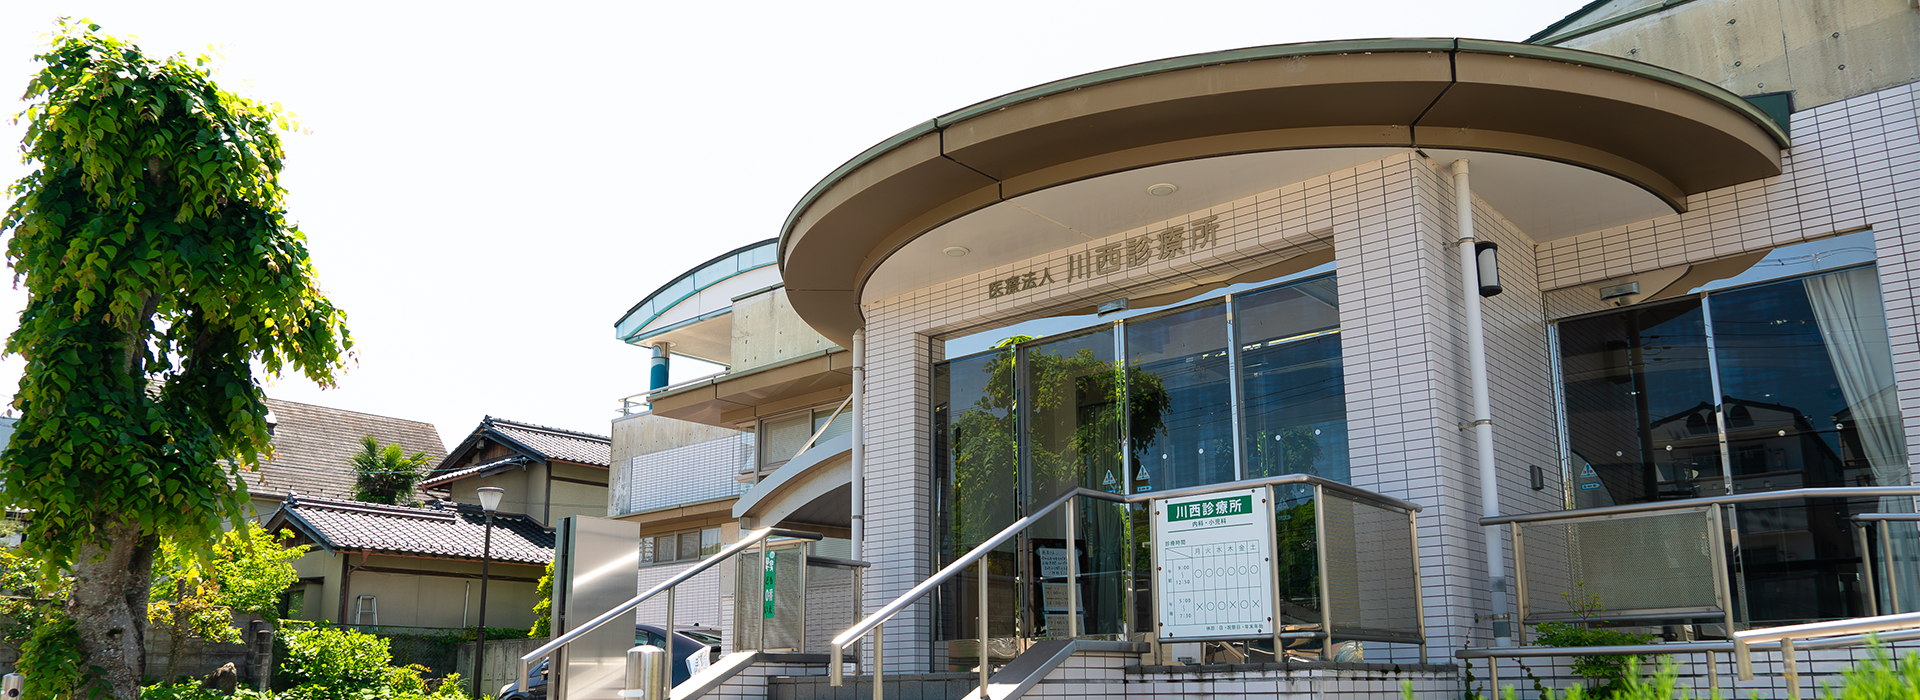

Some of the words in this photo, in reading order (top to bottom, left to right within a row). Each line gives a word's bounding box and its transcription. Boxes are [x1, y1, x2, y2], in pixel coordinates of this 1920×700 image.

[988, 267, 1056, 300] 医療法人
[1067, 215, 1220, 284] 川西診療所
[1176, 499, 1242, 519] 川西診療所
[1192, 518, 1227, 528] 内科・小児科
[1165, 539, 1186, 547] 診療時間
